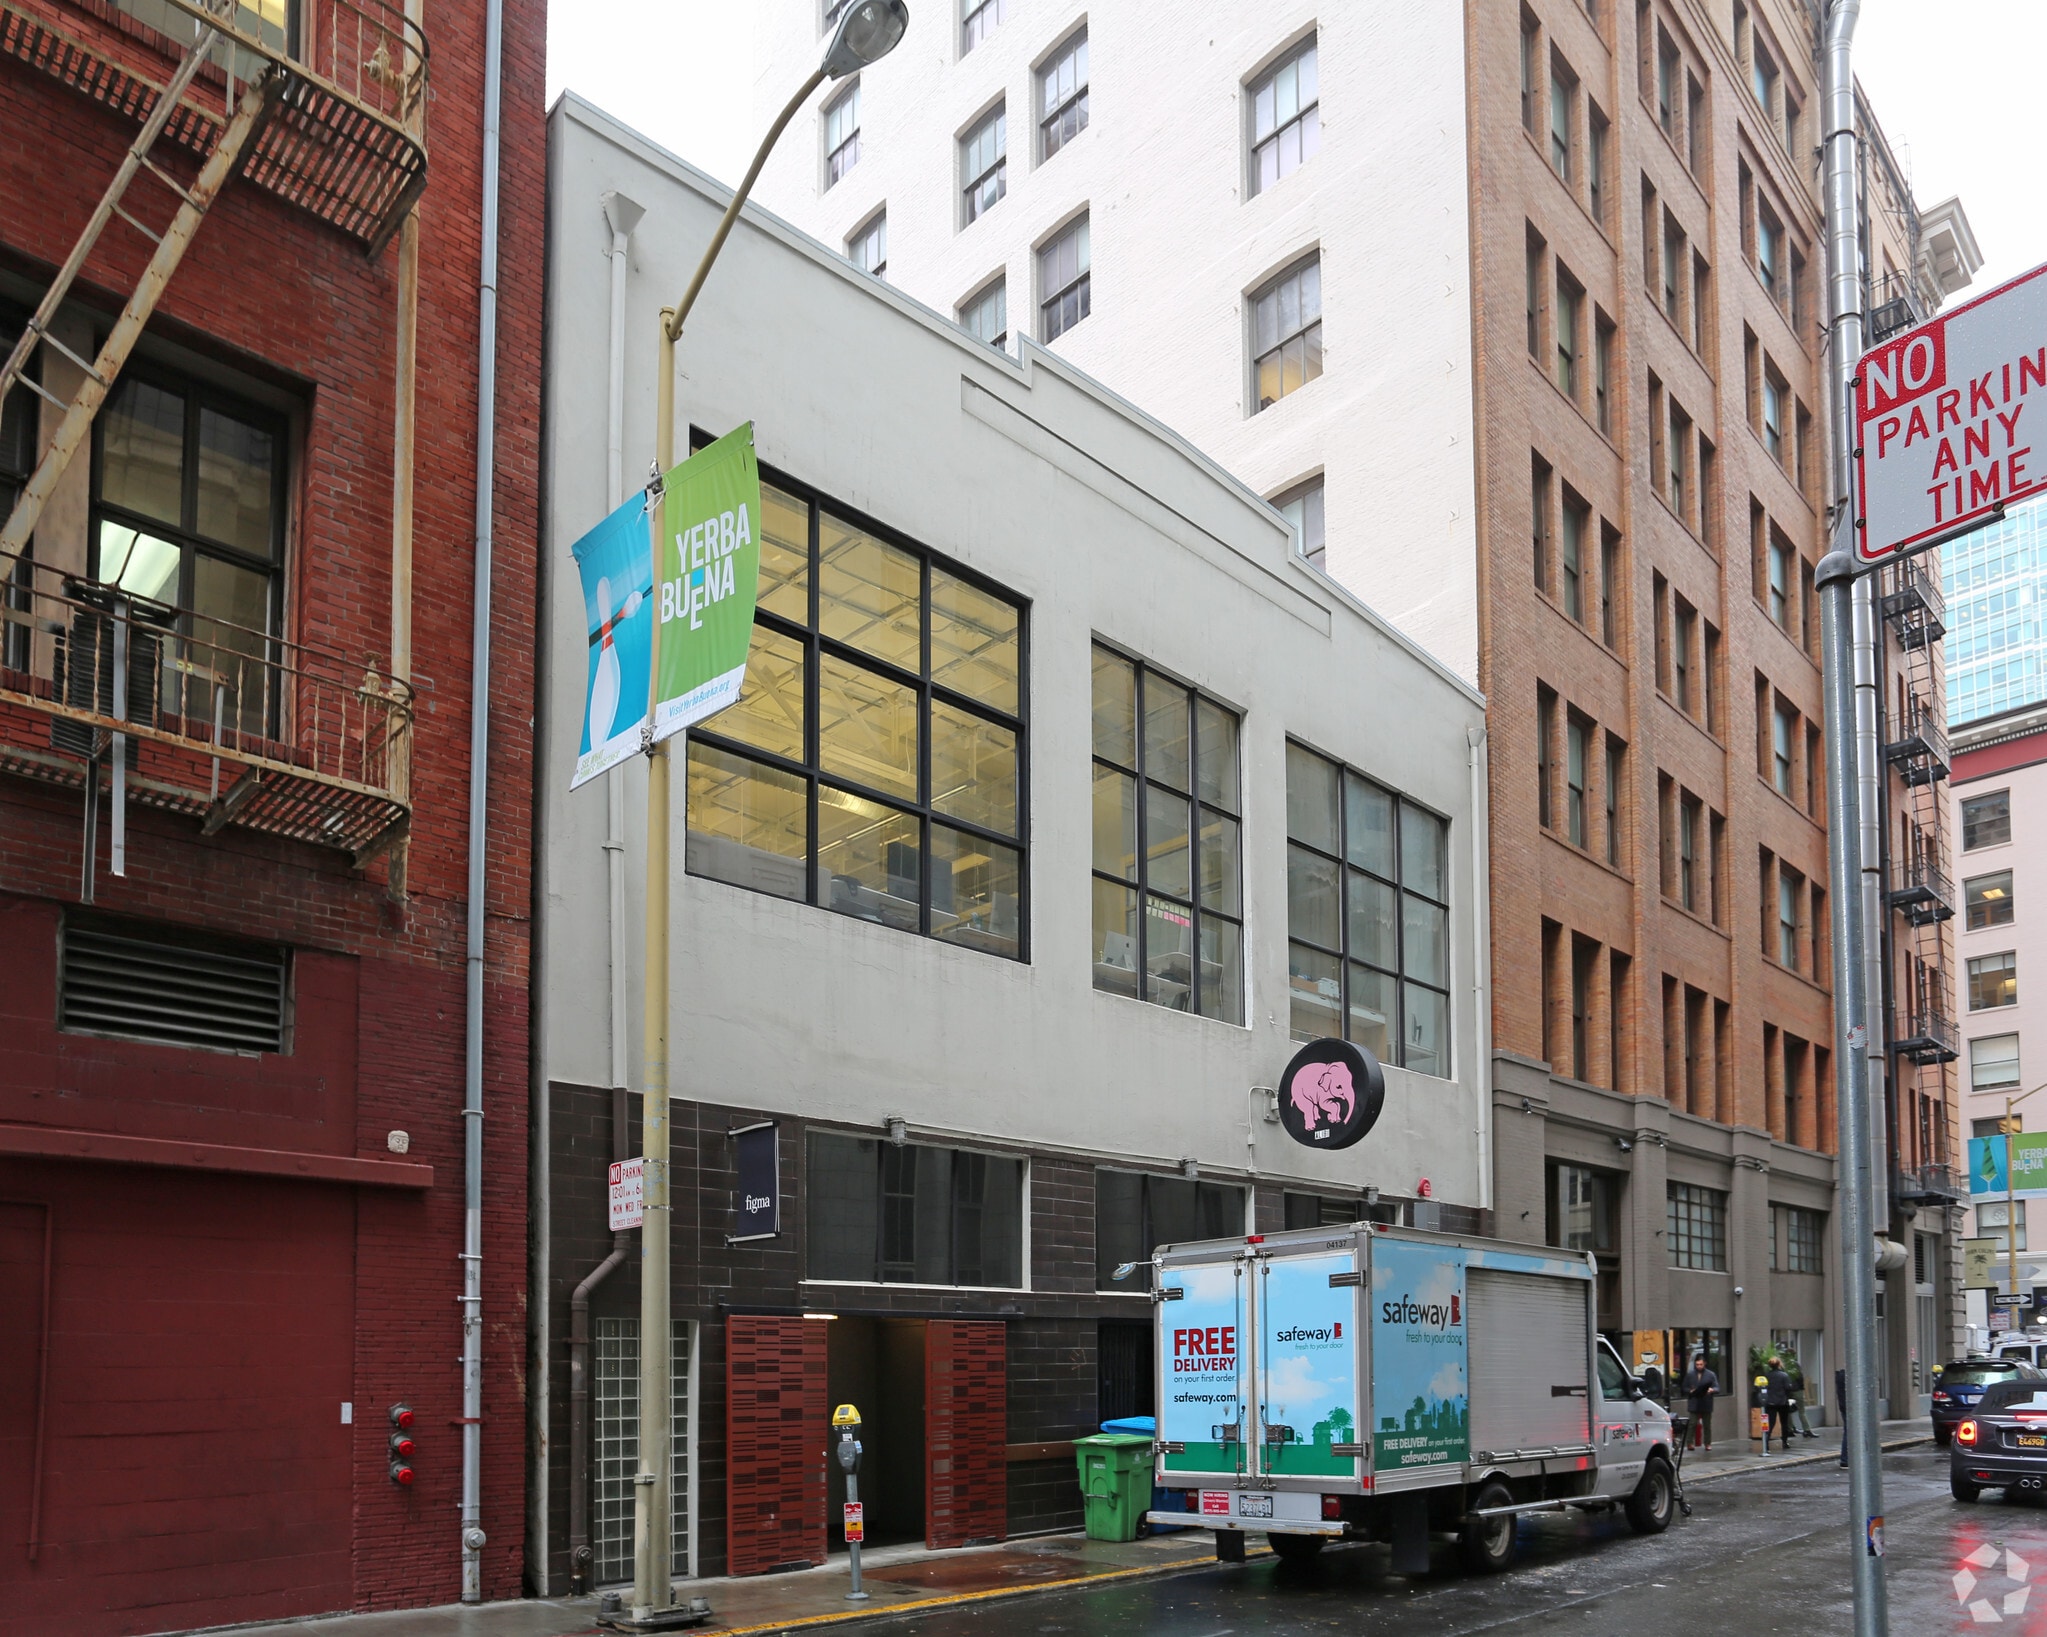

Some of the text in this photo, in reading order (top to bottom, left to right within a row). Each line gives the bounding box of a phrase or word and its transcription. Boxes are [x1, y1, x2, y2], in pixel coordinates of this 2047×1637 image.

[1866, 334, 1935, 411] NO
[1932, 403, 2023, 480] ANY
[1927, 446, 2033, 524] TIME
[675, 502, 751, 575] YERBA
[660, 555, 736, 632] BUENA
[669, 680, 731, 718] VisitYerbaBuena.org
[611, 1165, 621, 1185] NO
[2012, 1159, 2044, 1175] BUENA
[613, 1204, 622, 1214] MON
[625, 1202, 634, 1212] WED
[745, 1194, 771, 1214] figma
[1326, 1240, 1347, 1249] 04137
[1383, 1294, 1449, 1331] safeway
[1174, 1326, 1235, 1356] FREE
[1277, 1326, 1332, 1342] safeway
[1406, 1329, 1422, 1343] fresh
[1424, 1332, 1429, 1343] to
[1429, 1334, 1446, 1346] your
[1174, 1357, 1236, 1372] DELIVERY
[1185, 1376, 1200, 1384] your
[1201, 1374, 1214, 1382] first
[1174, 1392, 1237, 1405] safeway.com
[1383, 1439, 1399, 1450] FREE
[1400, 1437, 1428, 1449] DELIVERY
[1434, 1440, 1444, 1448] your
[1444, 1437, 1453, 1445] first
[1401, 1450, 1448, 1464] safeway.com
